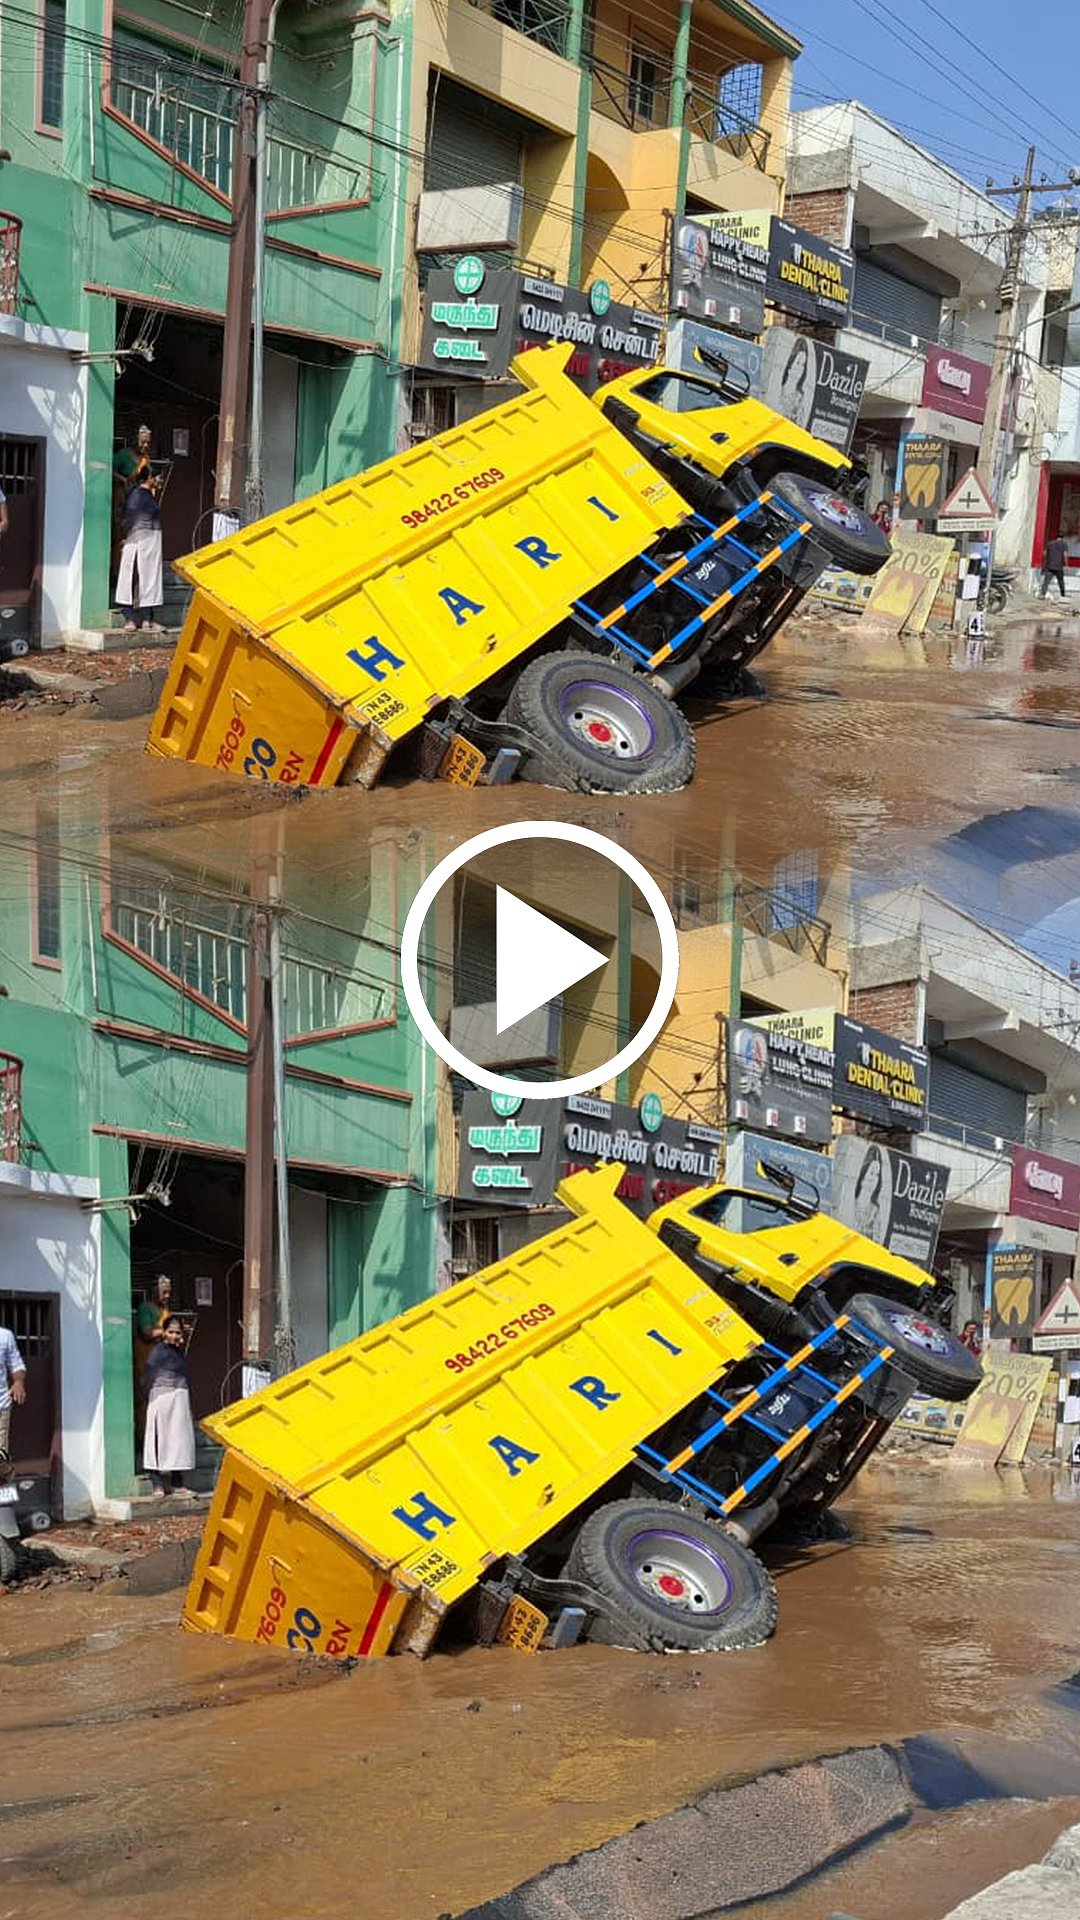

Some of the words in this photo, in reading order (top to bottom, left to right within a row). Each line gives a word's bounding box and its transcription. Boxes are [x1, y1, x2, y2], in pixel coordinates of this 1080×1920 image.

[710, 216, 742, 230] THAARA
[728, 226, 760, 238] CLINIC
[710, 229, 741, 252] HAPPY
[742, 240, 770, 265] HEART
[780, 260, 818, 292] DENTAL
[820, 279, 850, 303] CLINIC
[802, 249, 841, 284] THAARA
[431, 297, 499, 332] மருந்து
[433, 337, 488, 361] கடை
[817, 351, 863, 398] Dazzle
[970, 618, 979, 632] 4
[243, 738, 277, 780] CO
[279, 750, 305, 783] RN
[768, 1016, 803, 1032] THAARA
[788, 1027, 823, 1040] CLINIC
[769, 1032, 804, 1057] HAPPY
[805, 1043, 836, 1068] HEART
[871, 1049, 915, 1084] THAARA
[848, 1062, 891, 1096] DENTAL
[892, 1080, 925, 1105] CLINIC
[468, 1119, 542, 1158] மருந்து
[472, 1165, 532, 1188] கடை
[894, 1159, 944, 1208] Dazzle
[287, 1607, 321, 1652] CO
[326, 1619, 352, 1654] RN
